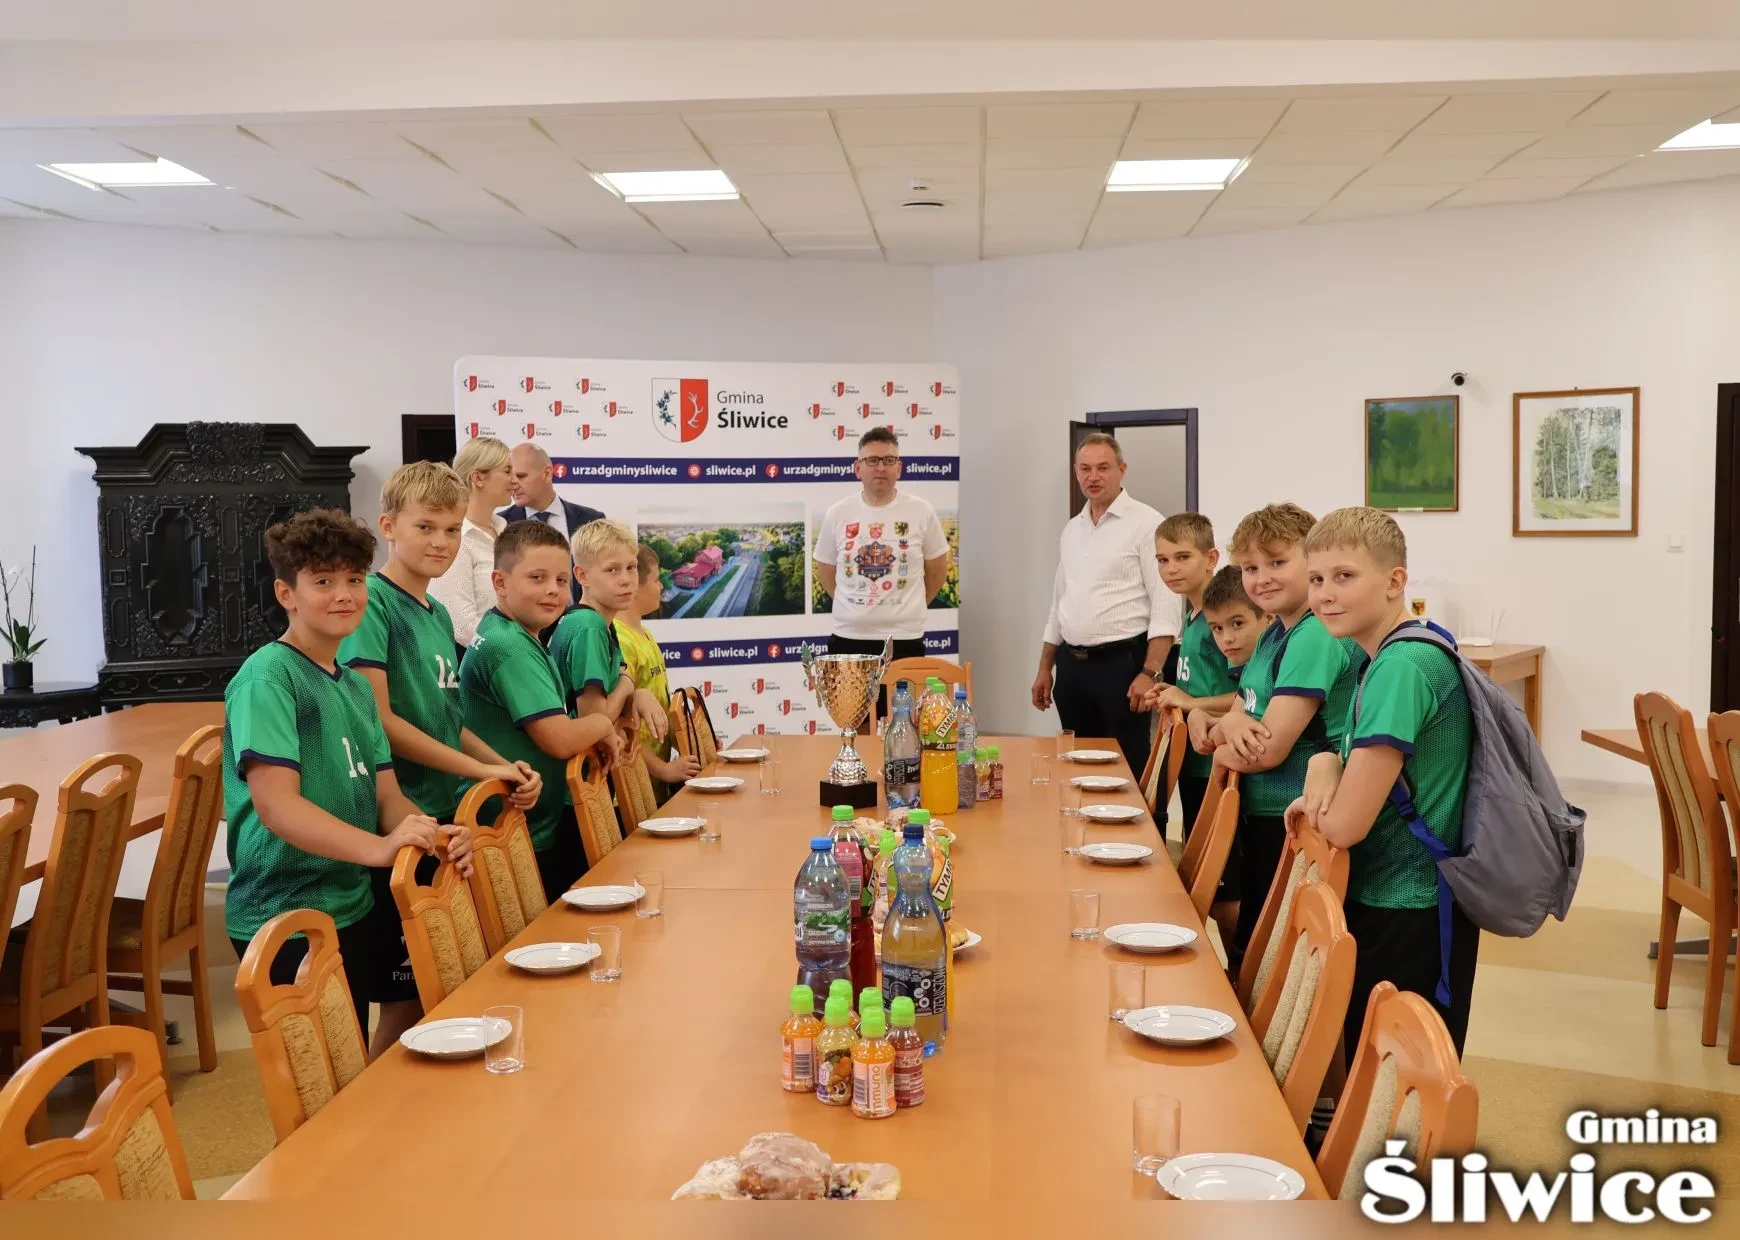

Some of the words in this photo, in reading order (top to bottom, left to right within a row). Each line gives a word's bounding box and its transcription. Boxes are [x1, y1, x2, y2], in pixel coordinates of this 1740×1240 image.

[717, 391, 764, 404] Gmina
[717, 410, 788, 428] Śliwice
[572, 464, 678, 478] urzadgminysliwice
[705, 465, 756, 478] sliwice.pl
[783, 464, 855, 477] urzadgminysl
[906, 463, 952, 474] sliwice.pl
[663, 649, 681, 660] ice
[708, 646, 758, 659] sliwice.pl
